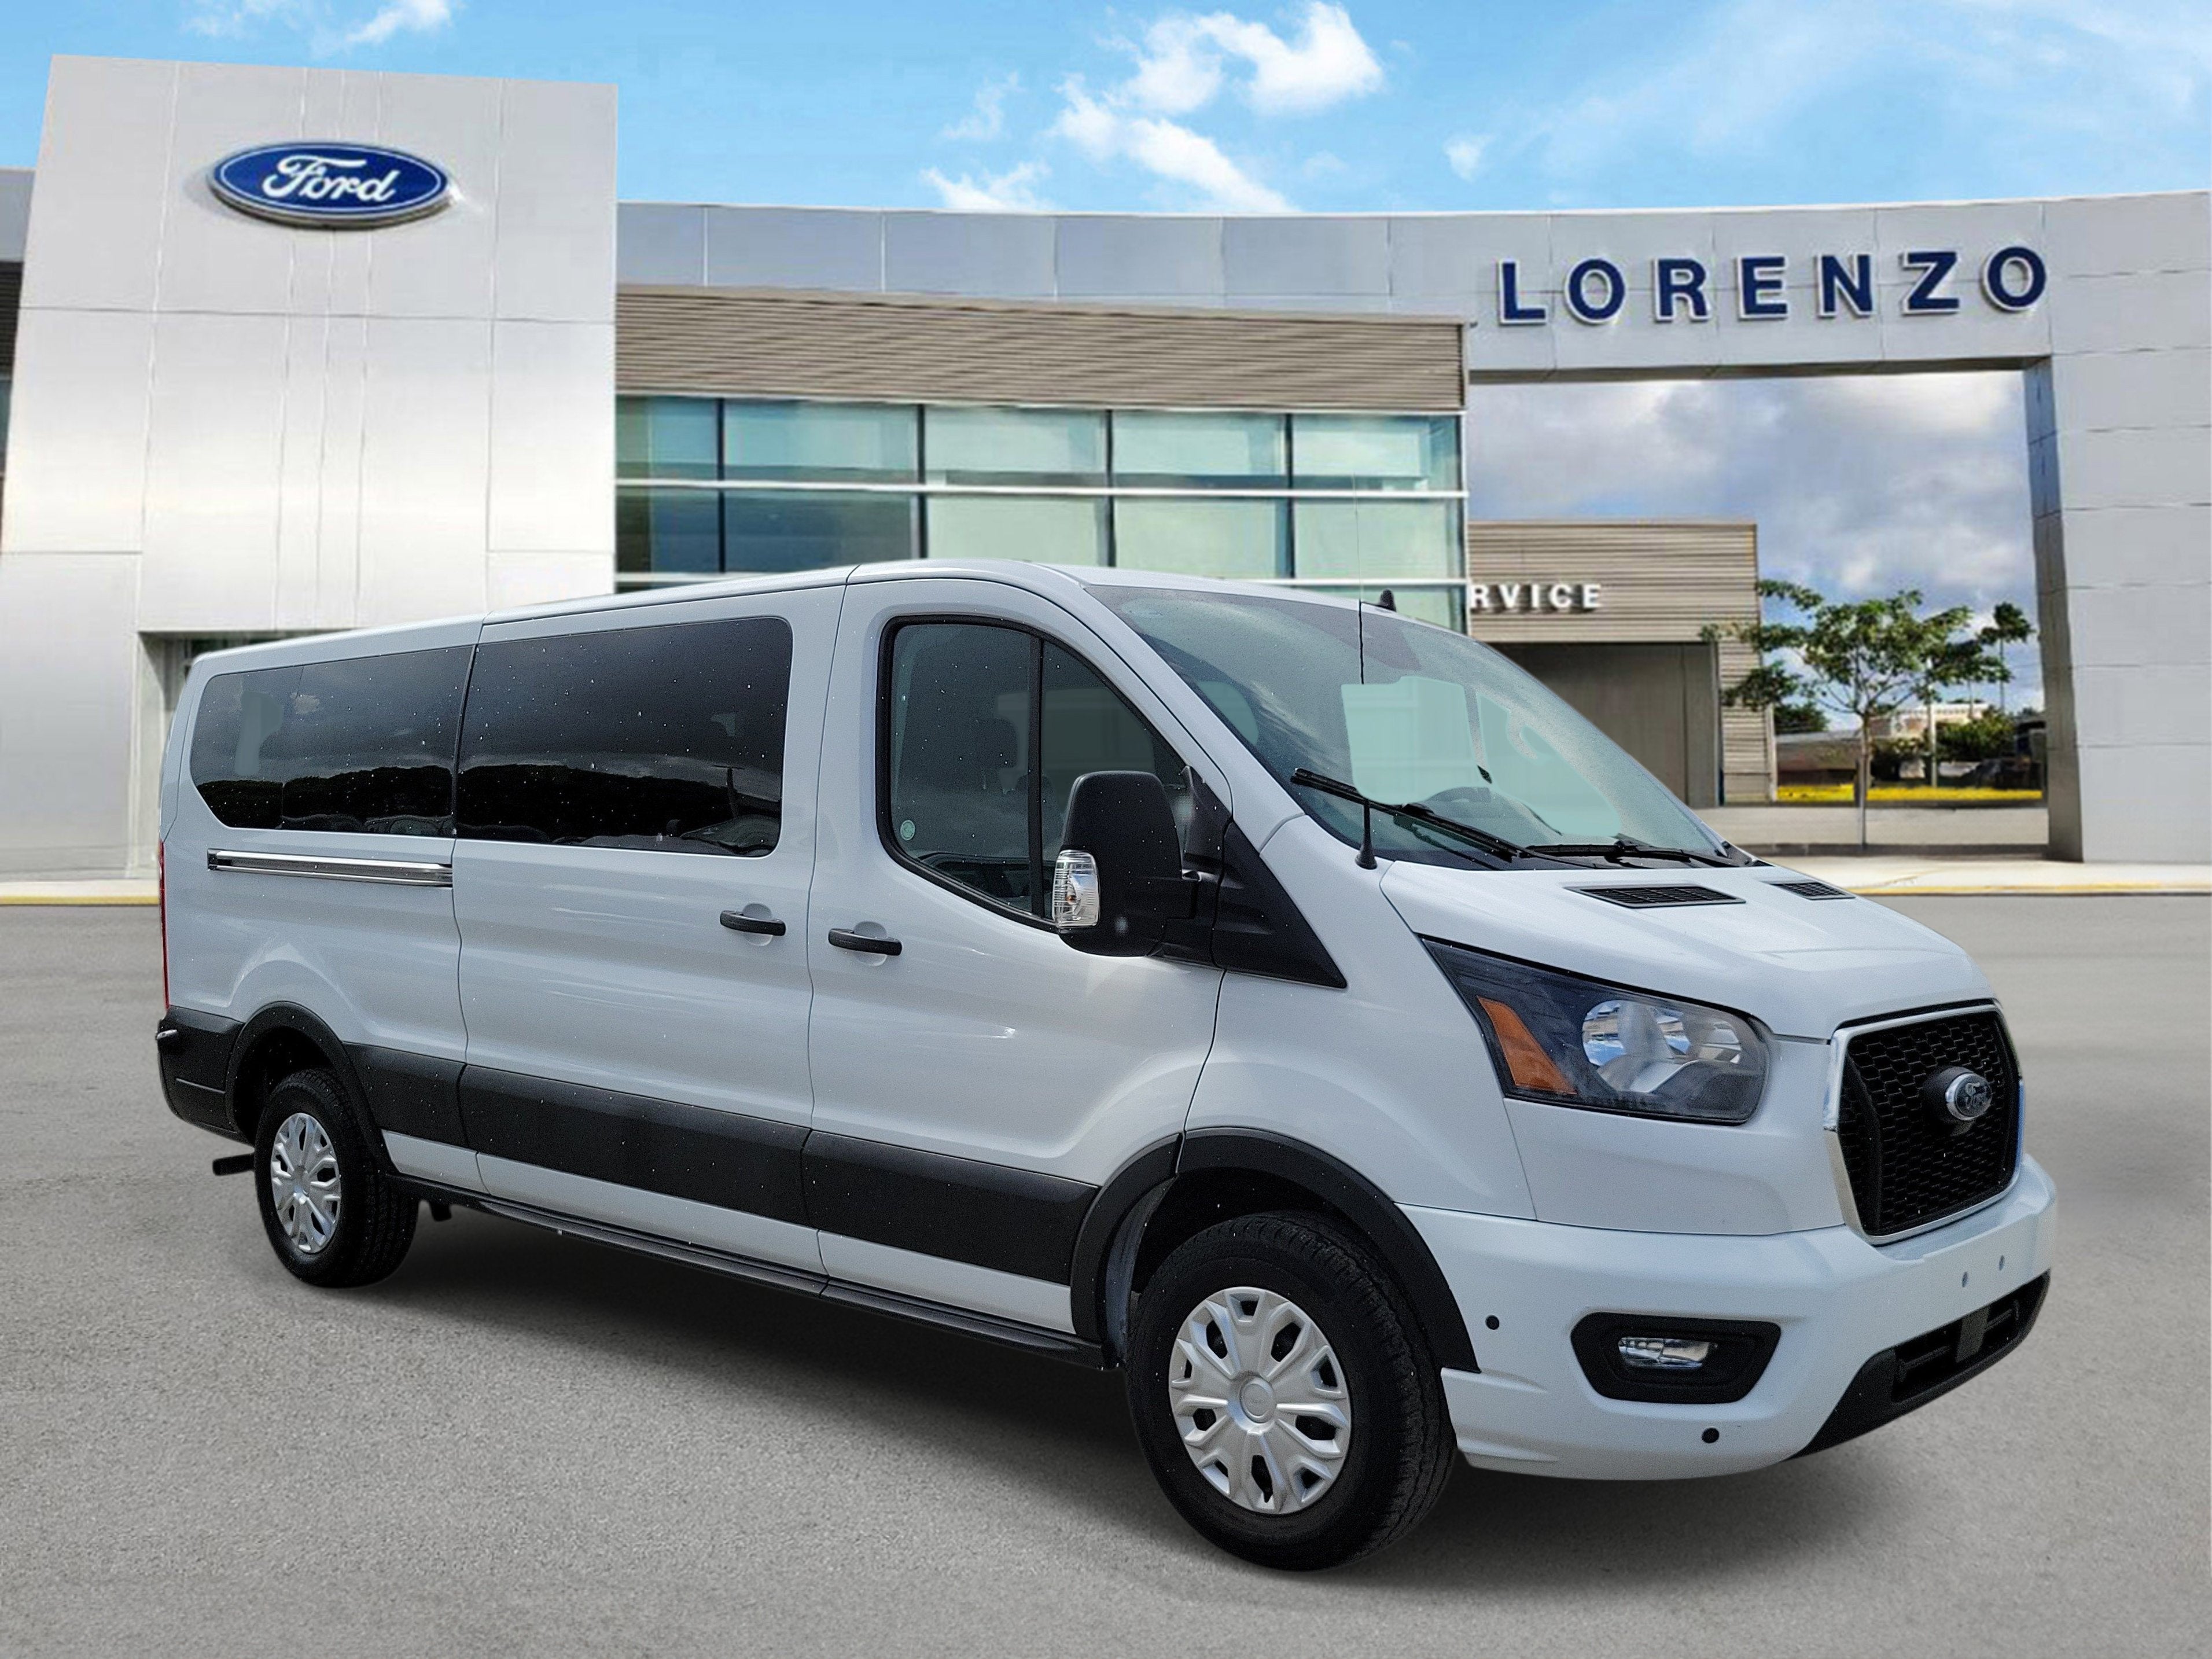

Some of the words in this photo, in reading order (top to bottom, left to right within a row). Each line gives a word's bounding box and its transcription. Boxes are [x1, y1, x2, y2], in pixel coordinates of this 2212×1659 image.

[263, 155, 401, 201] Ford
[1499, 247, 2047, 325] LORENZO
[1470, 584, 1602, 608] RVICE
